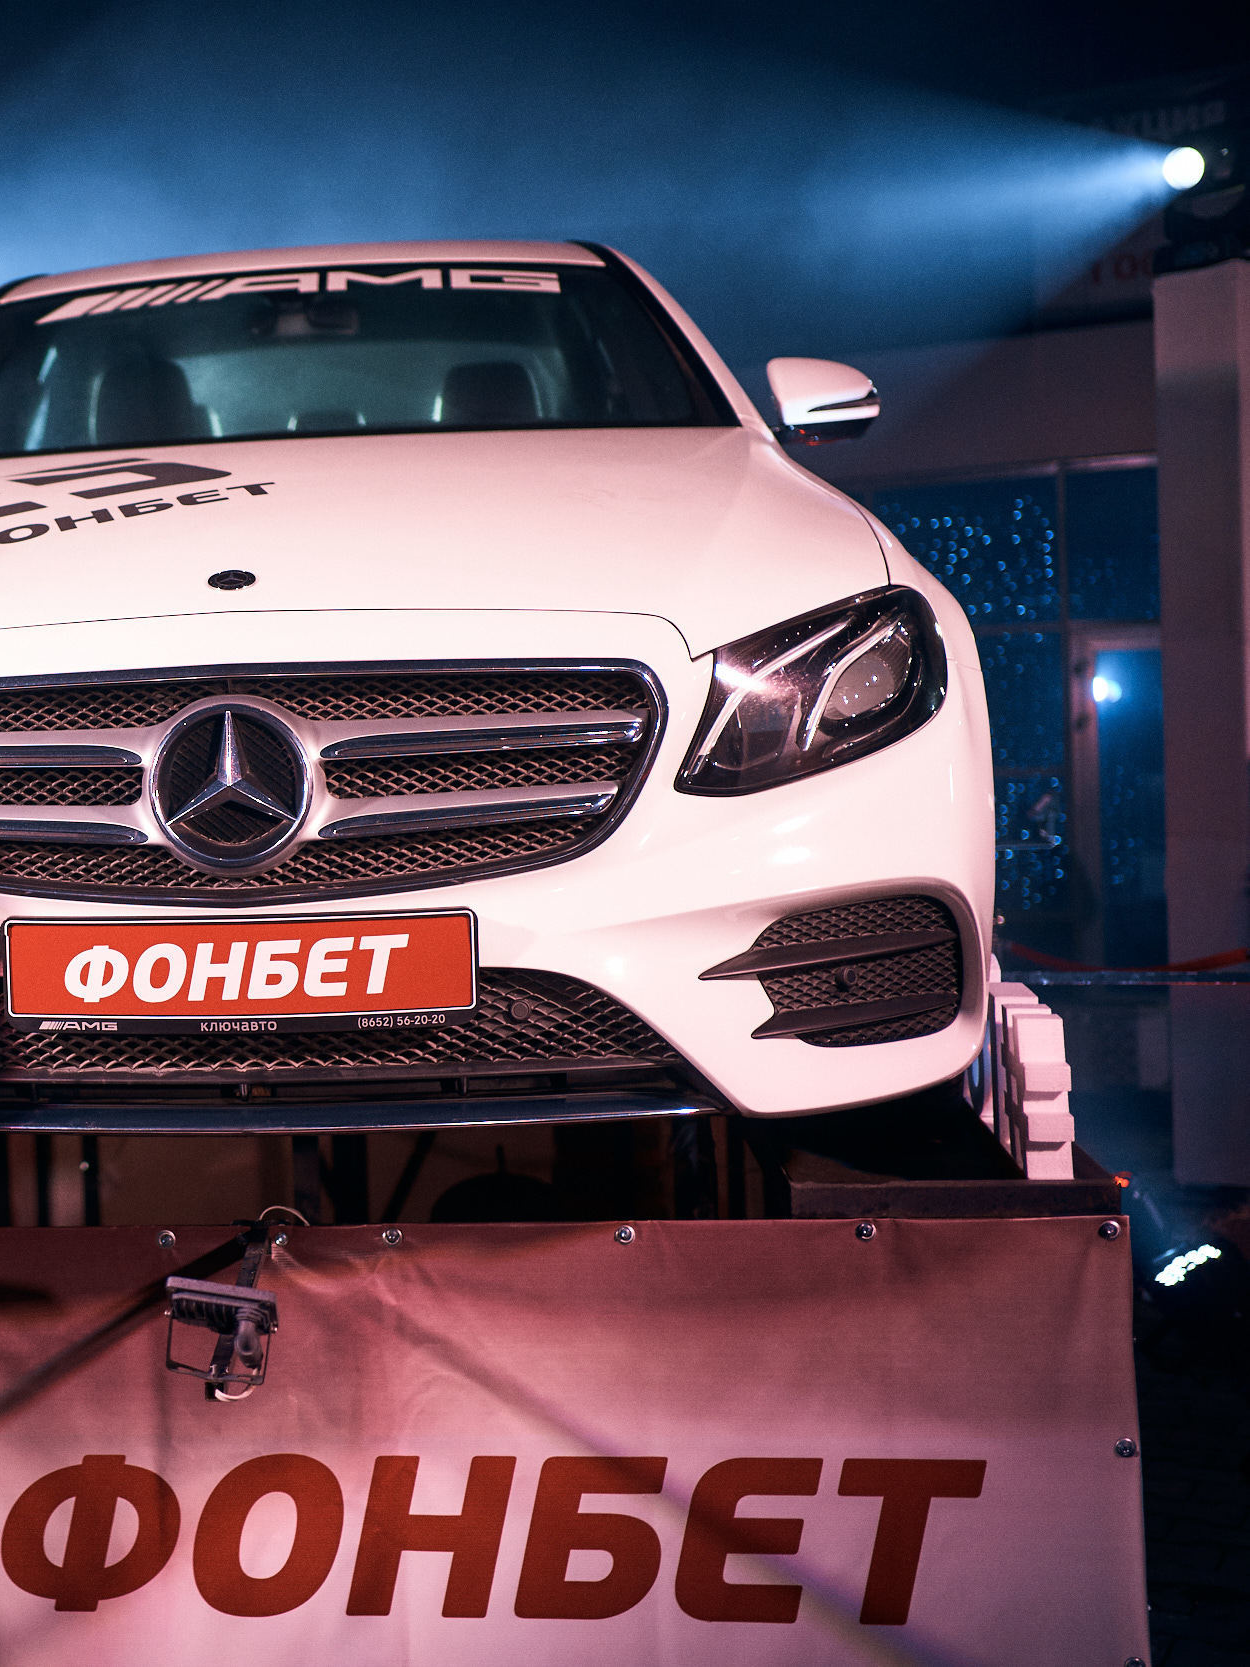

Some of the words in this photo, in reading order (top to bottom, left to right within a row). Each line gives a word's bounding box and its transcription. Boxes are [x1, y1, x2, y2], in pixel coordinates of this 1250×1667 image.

[198, 268, 561, 301] AMG
[64, 933, 410, 1003] ФОНБЕТ
[62, 1021, 118, 1031] AMG
[357, 1016, 394, 1029] (8652)
[396, 1013, 446, 1026] 56-20-20
[0, 1452, 987, 1626] ФОНБЕТ
